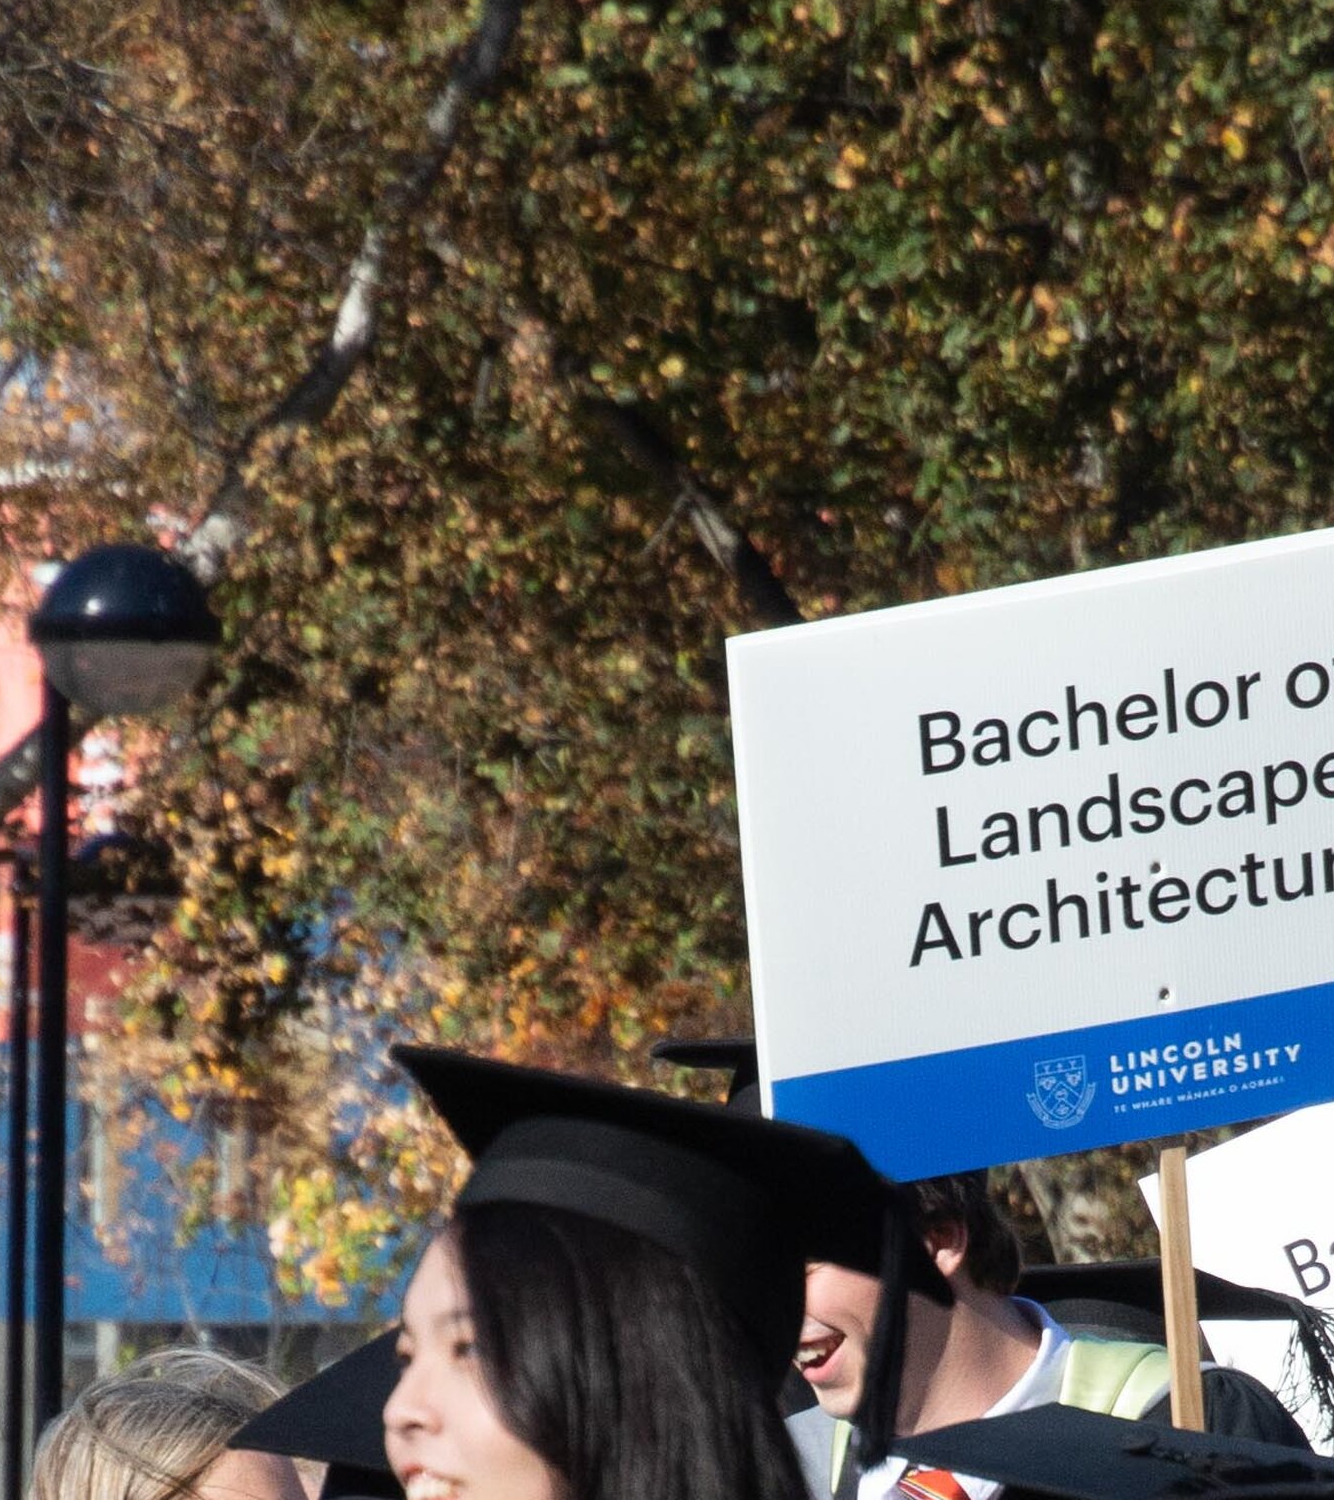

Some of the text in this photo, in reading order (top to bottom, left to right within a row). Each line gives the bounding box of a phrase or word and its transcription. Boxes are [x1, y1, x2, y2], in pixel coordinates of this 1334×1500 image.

[919, 667, 1261, 776] Bachelor
[1110, 1032, 1242, 1073] LINCOLN
[1111, 1044, 1301, 1095] UNIVERSITY
[1113, 1104, 1127, 1114] TE
[1131, 1096, 1173, 1111] WHARE
[1228, 1084, 1238, 1094] O
